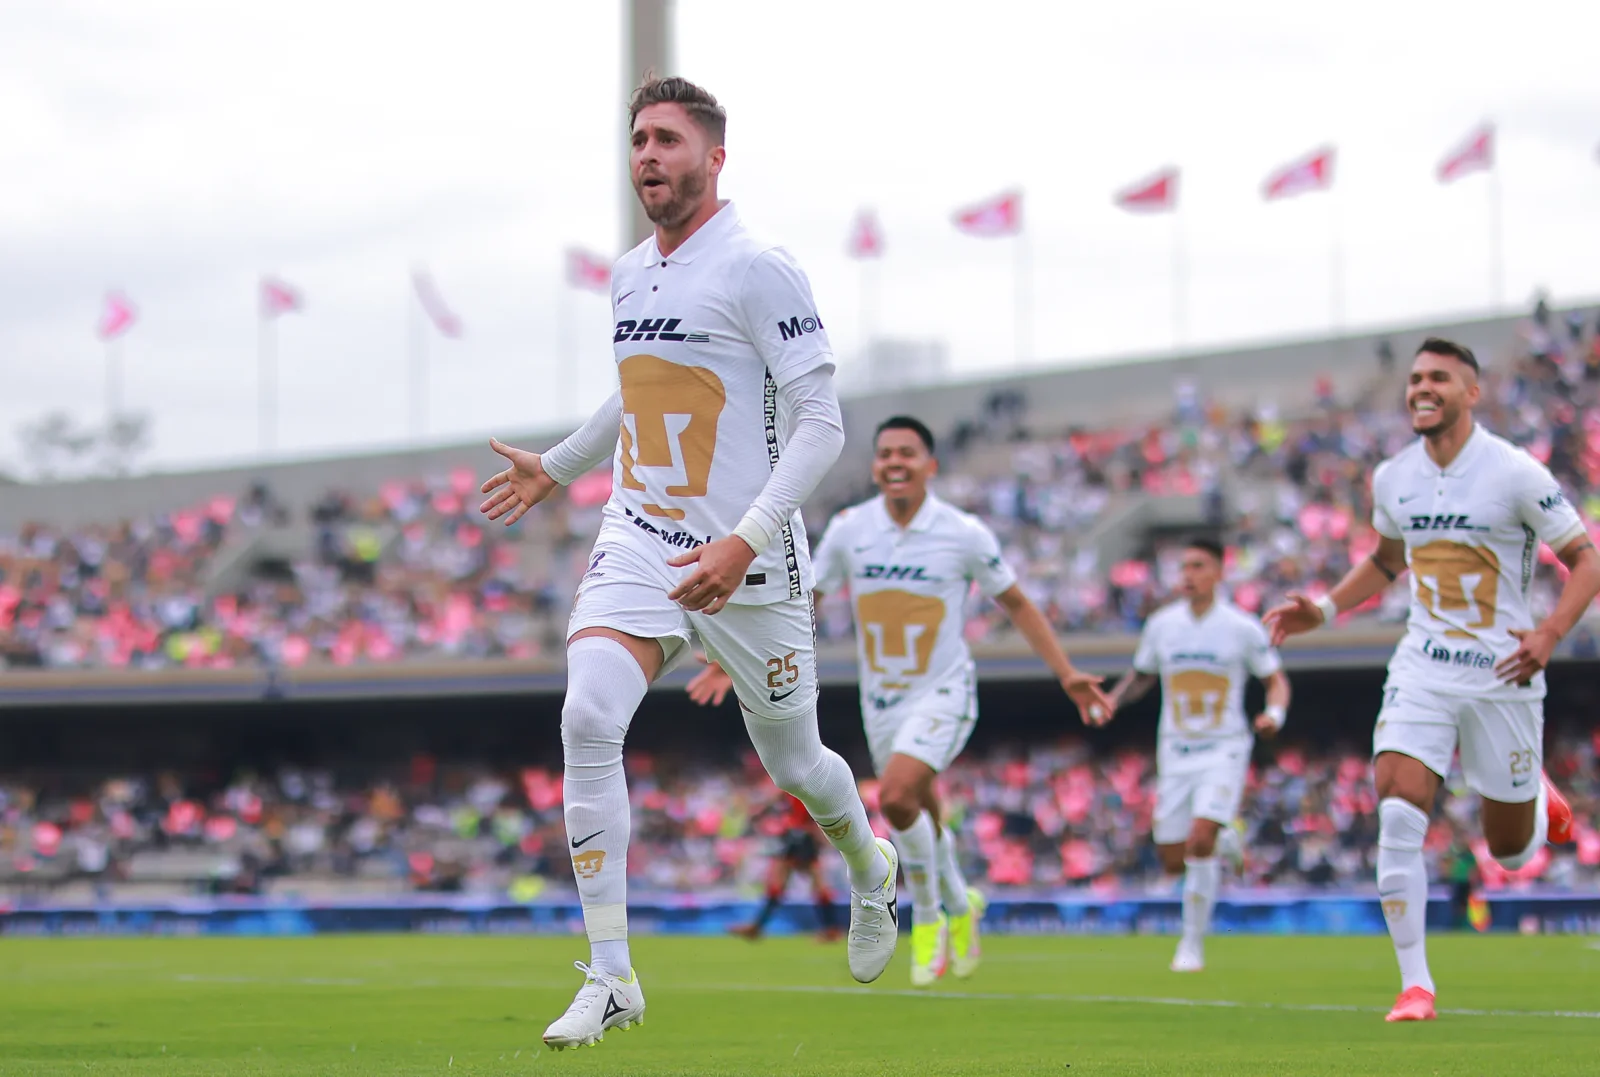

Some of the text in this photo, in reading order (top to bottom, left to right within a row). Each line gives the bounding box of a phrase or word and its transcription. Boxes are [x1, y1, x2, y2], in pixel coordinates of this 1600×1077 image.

[614, 318, 688, 343] DHL
[765, 378, 776, 427] PUMAS
[1410, 513, 1475, 531] DHL
[864, 564, 928, 580] DHL
[767, 651, 799, 688] 25
[1454, 650, 1496, 669] Mifel
[1509, 750, 1533, 775] 23
